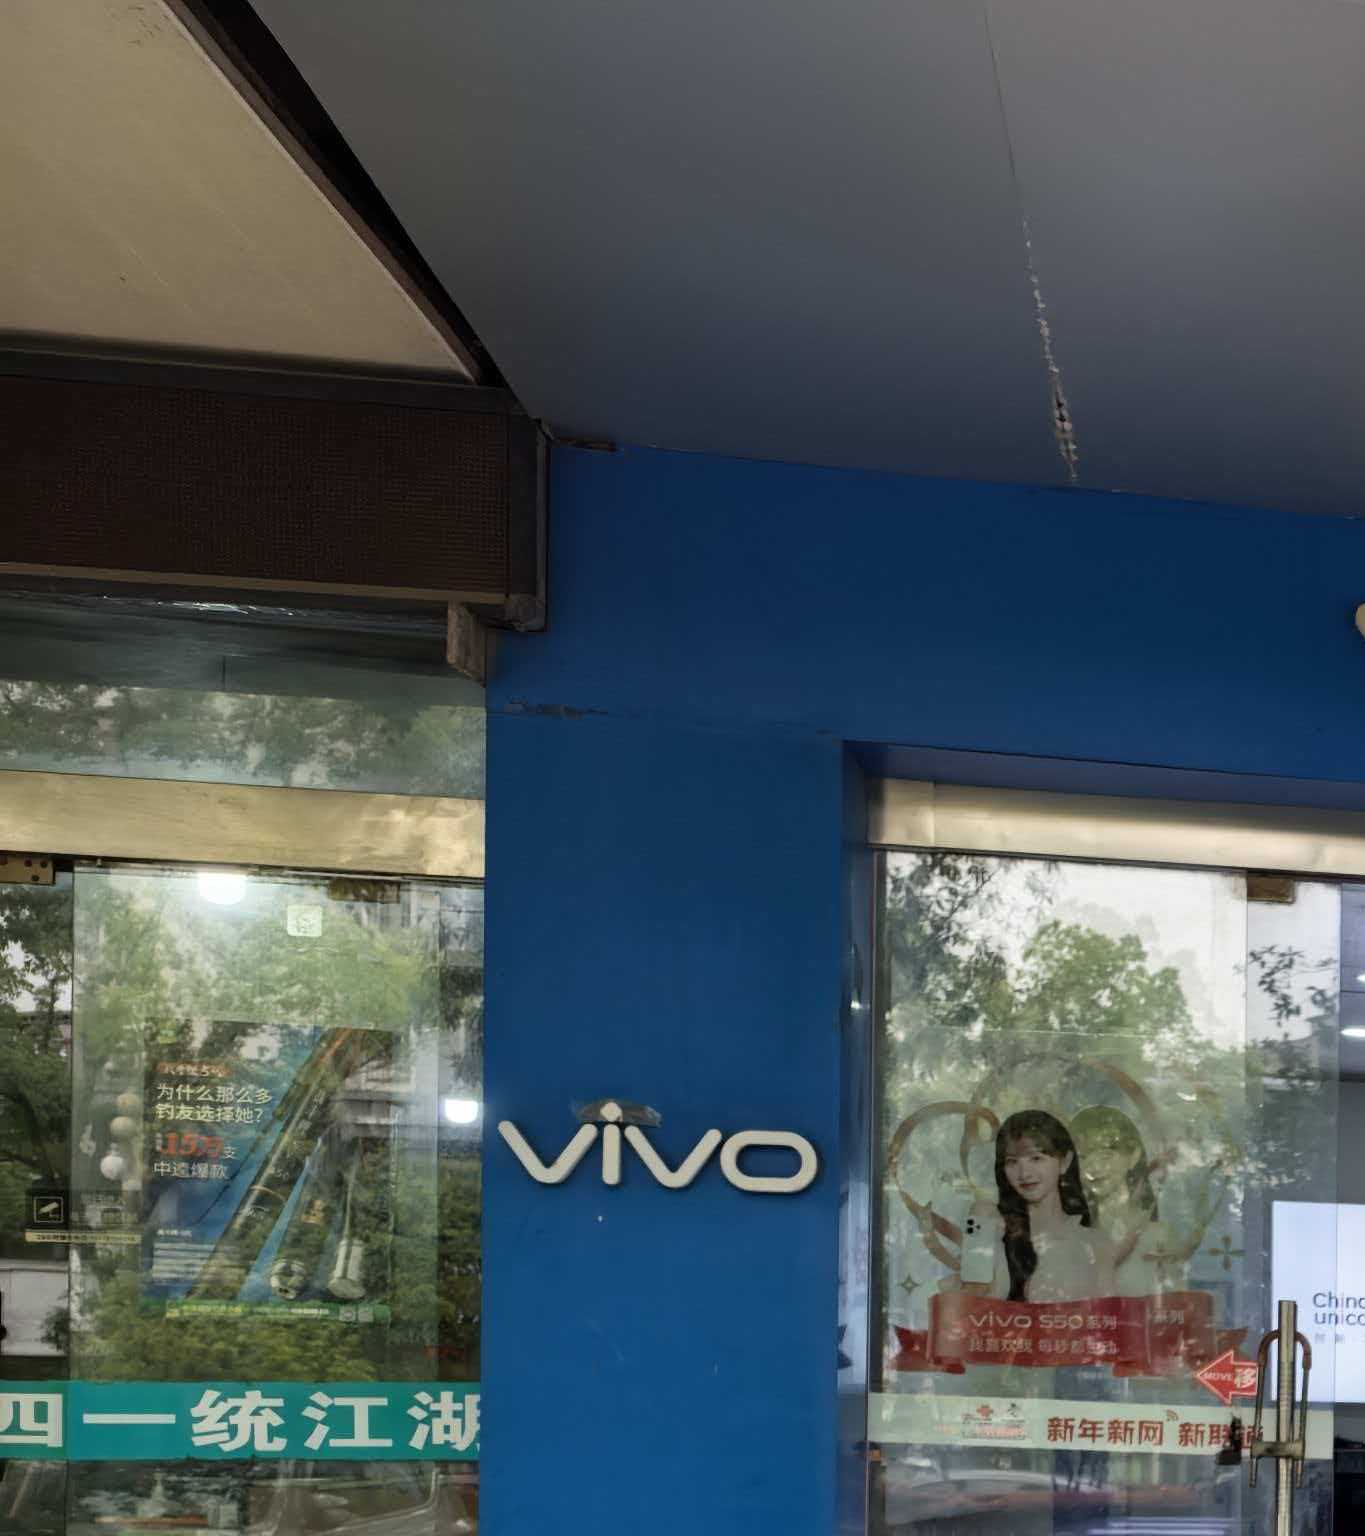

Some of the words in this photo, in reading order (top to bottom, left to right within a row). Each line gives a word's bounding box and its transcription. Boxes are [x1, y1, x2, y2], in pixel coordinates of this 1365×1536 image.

[156, 1083, 273, 1105] 为什么那么多
[497, 1100, 818, 1193] vivo
[969, 1311, 1032, 1328] vivo
[1039, 1313, 1083, 1330] S50
[0, 1388, 481, 1453] 四一统江湖
[1046, 1415, 1164, 1446] 新年新网
